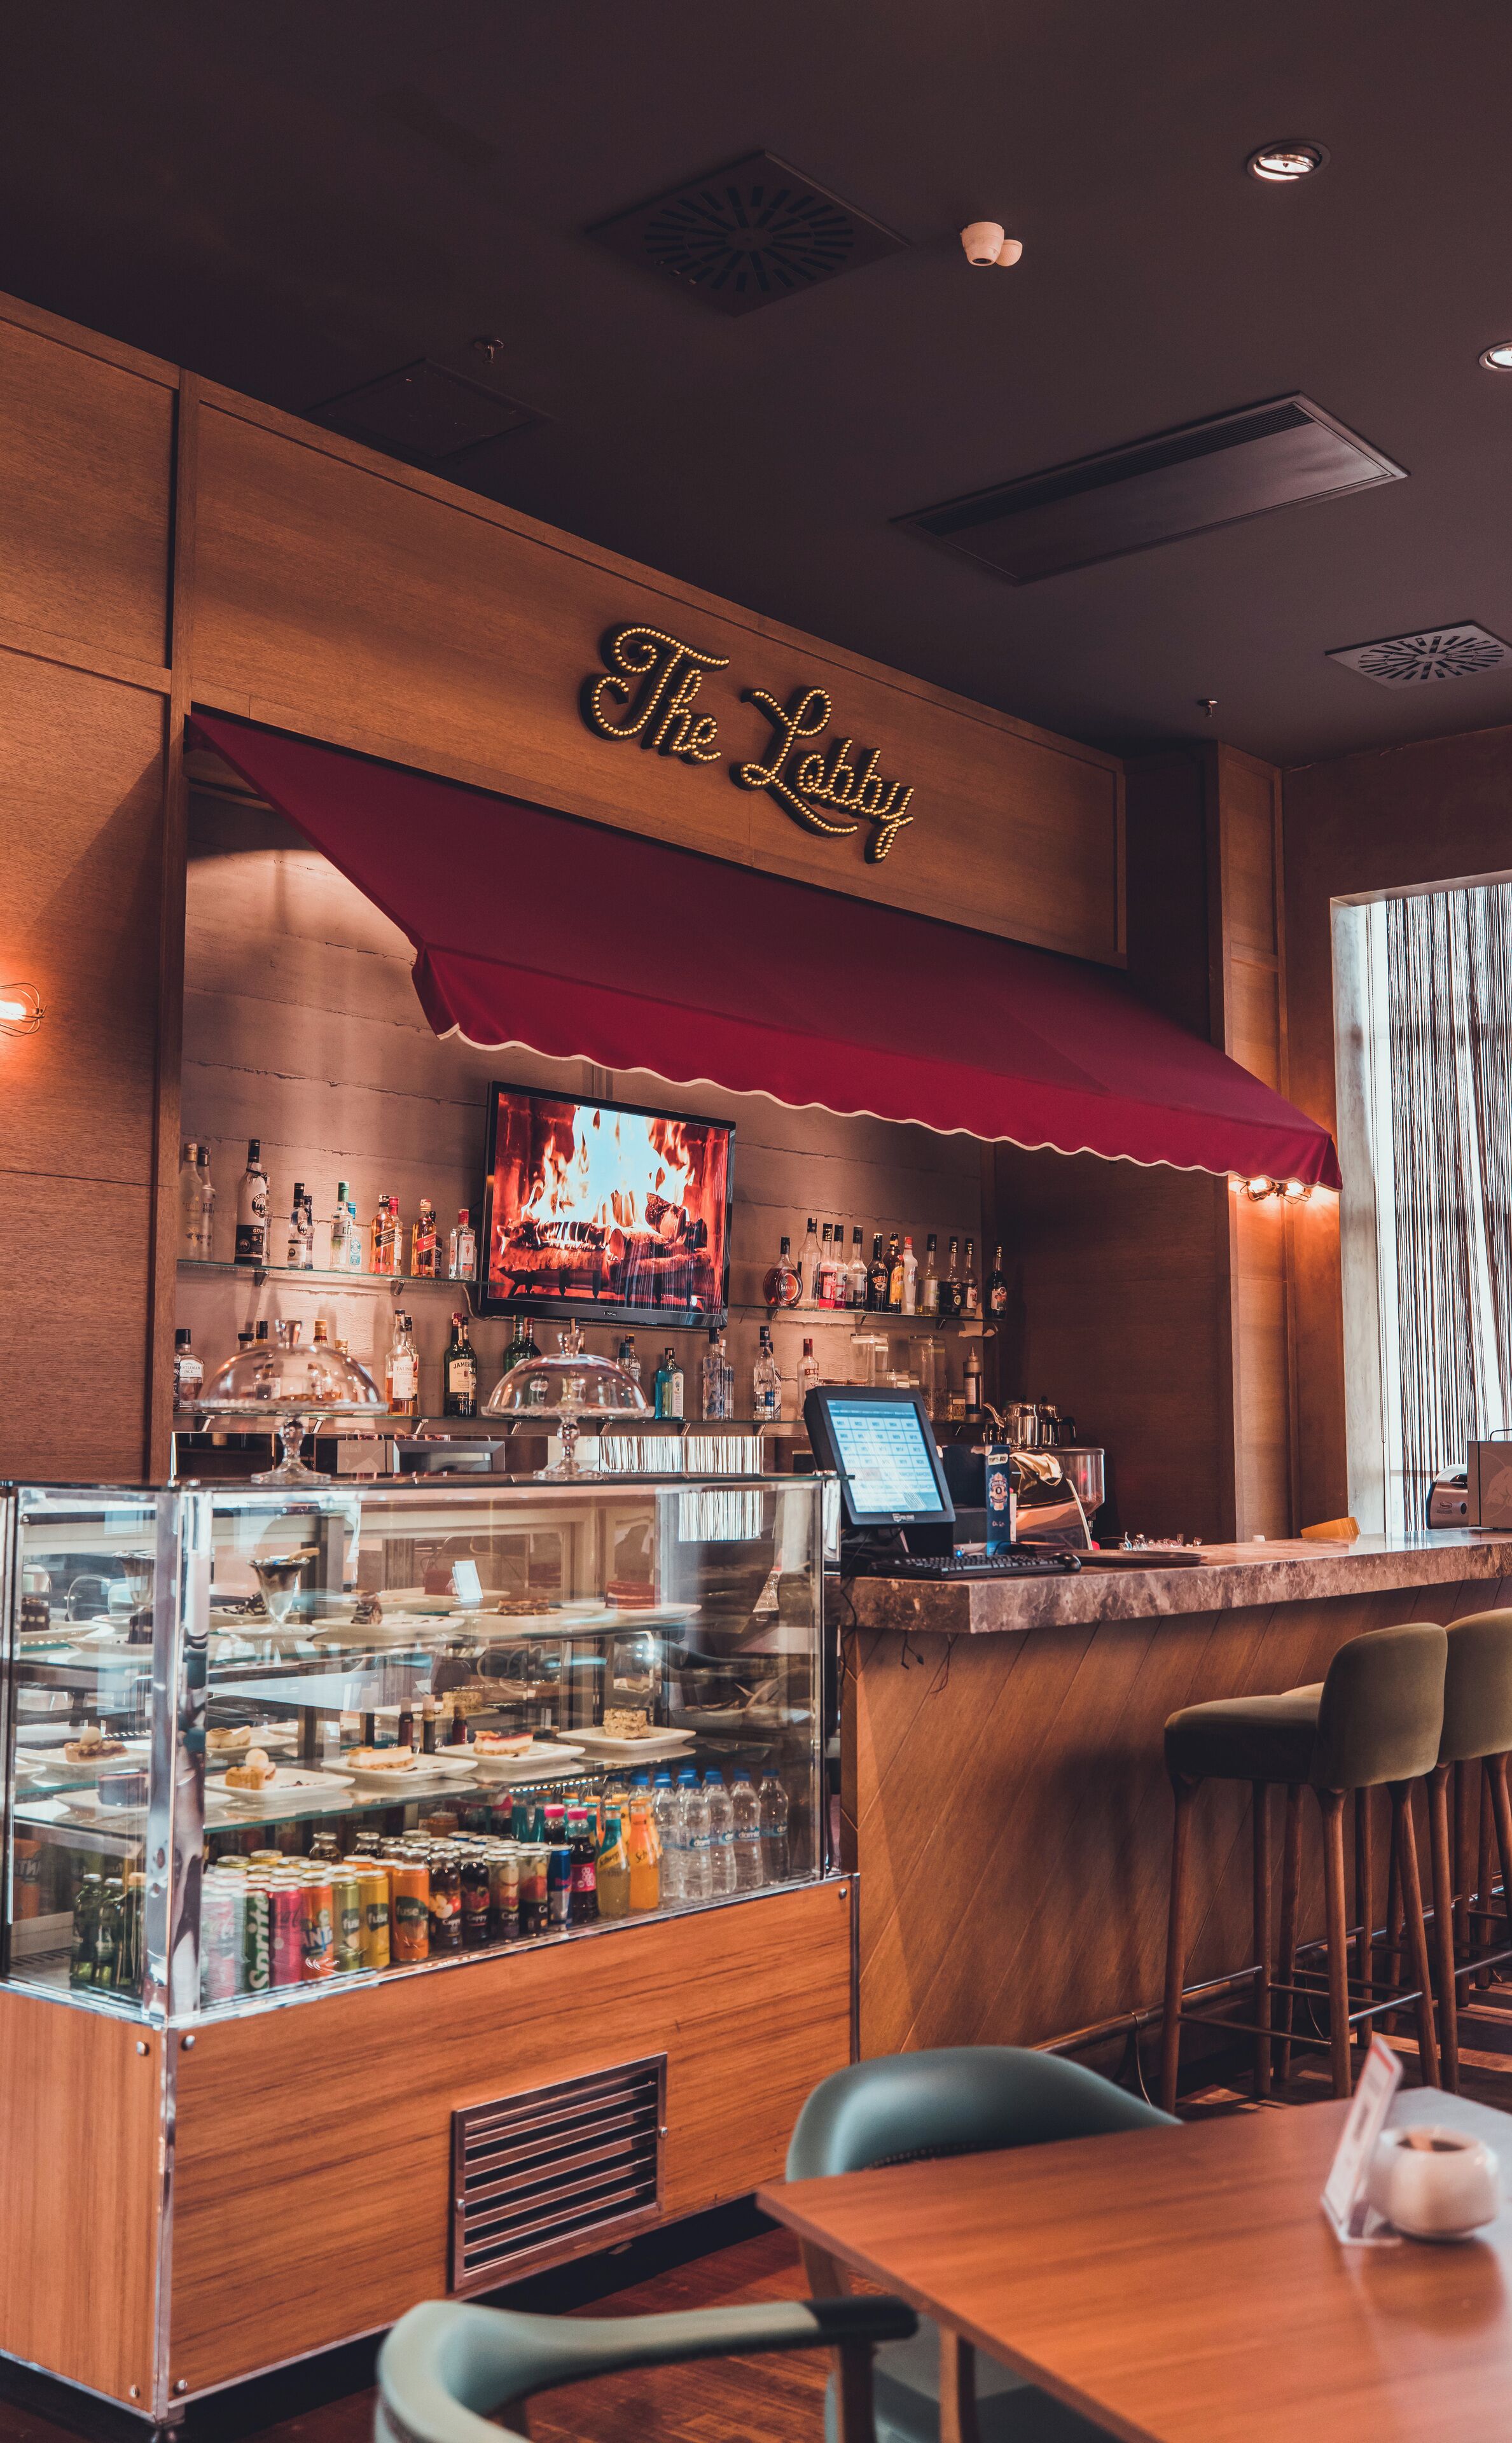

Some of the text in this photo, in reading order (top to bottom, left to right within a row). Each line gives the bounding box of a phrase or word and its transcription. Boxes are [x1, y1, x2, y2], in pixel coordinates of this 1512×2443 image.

[586, 623, 914, 863] The Lobby
[247, 1896, 270, 1989] Sprite
